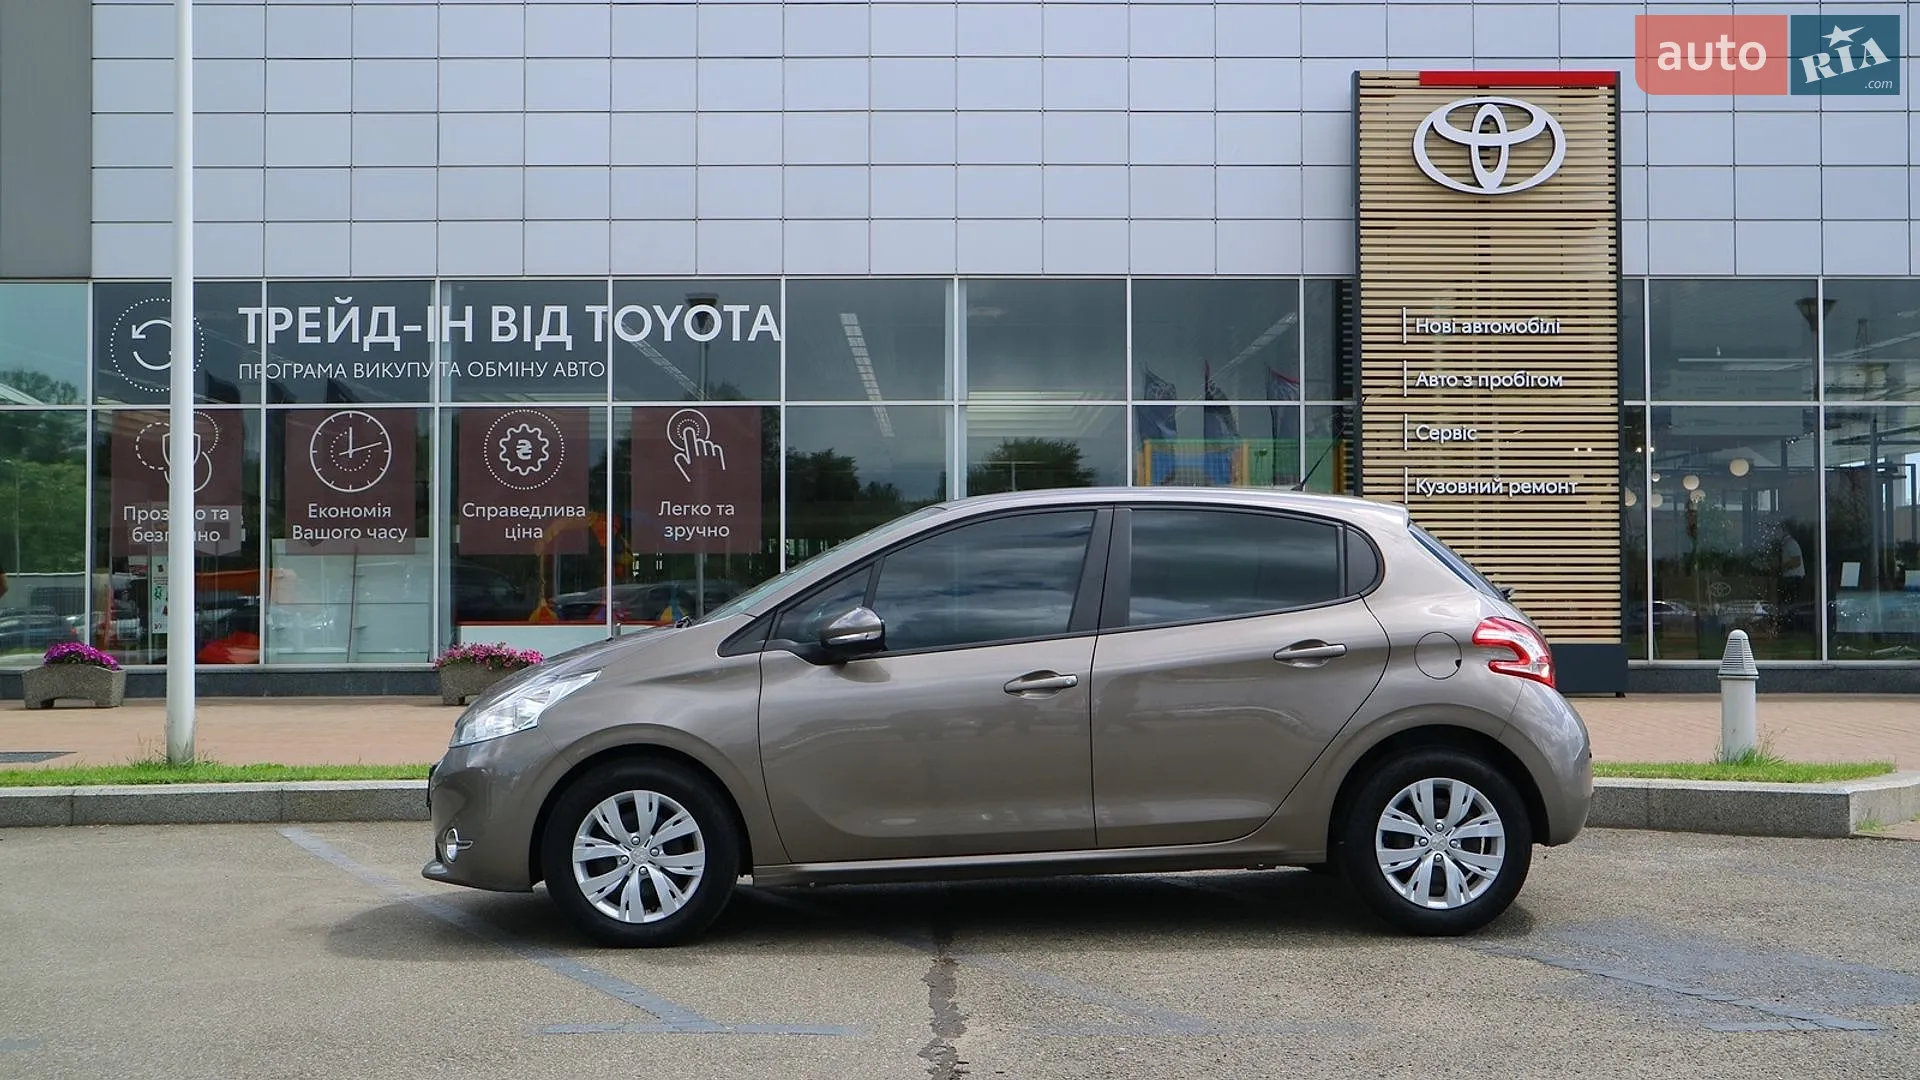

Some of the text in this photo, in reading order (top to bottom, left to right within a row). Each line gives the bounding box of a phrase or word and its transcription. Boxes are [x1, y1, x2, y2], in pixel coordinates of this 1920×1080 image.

[238, 296, 782, 352] ТРЕЙД-ІН ВІД TOYOTA
[1415, 317, 1561, 334] Нові автомобілі
[239, 360, 605, 379] ПРОГРАМА ВИКУПУ ТА ОБМІНУ АВТО
[1415, 371, 1563, 391] Авто з пробігом
[1415, 424, 1478, 444] Сервіс
[1415, 474, 1578, 497] Кузовний ремонт
[123, 506, 229, 524] Прозо та
[308, 502, 392, 518] Економія
[462, 502, 586, 519] Справедлива
[658, 500, 735, 516] Легко та
[292, 525, 408, 543] Вашого часу
[504, 523, 543, 539] ціна
[663, 524, 730, 541] зручно
